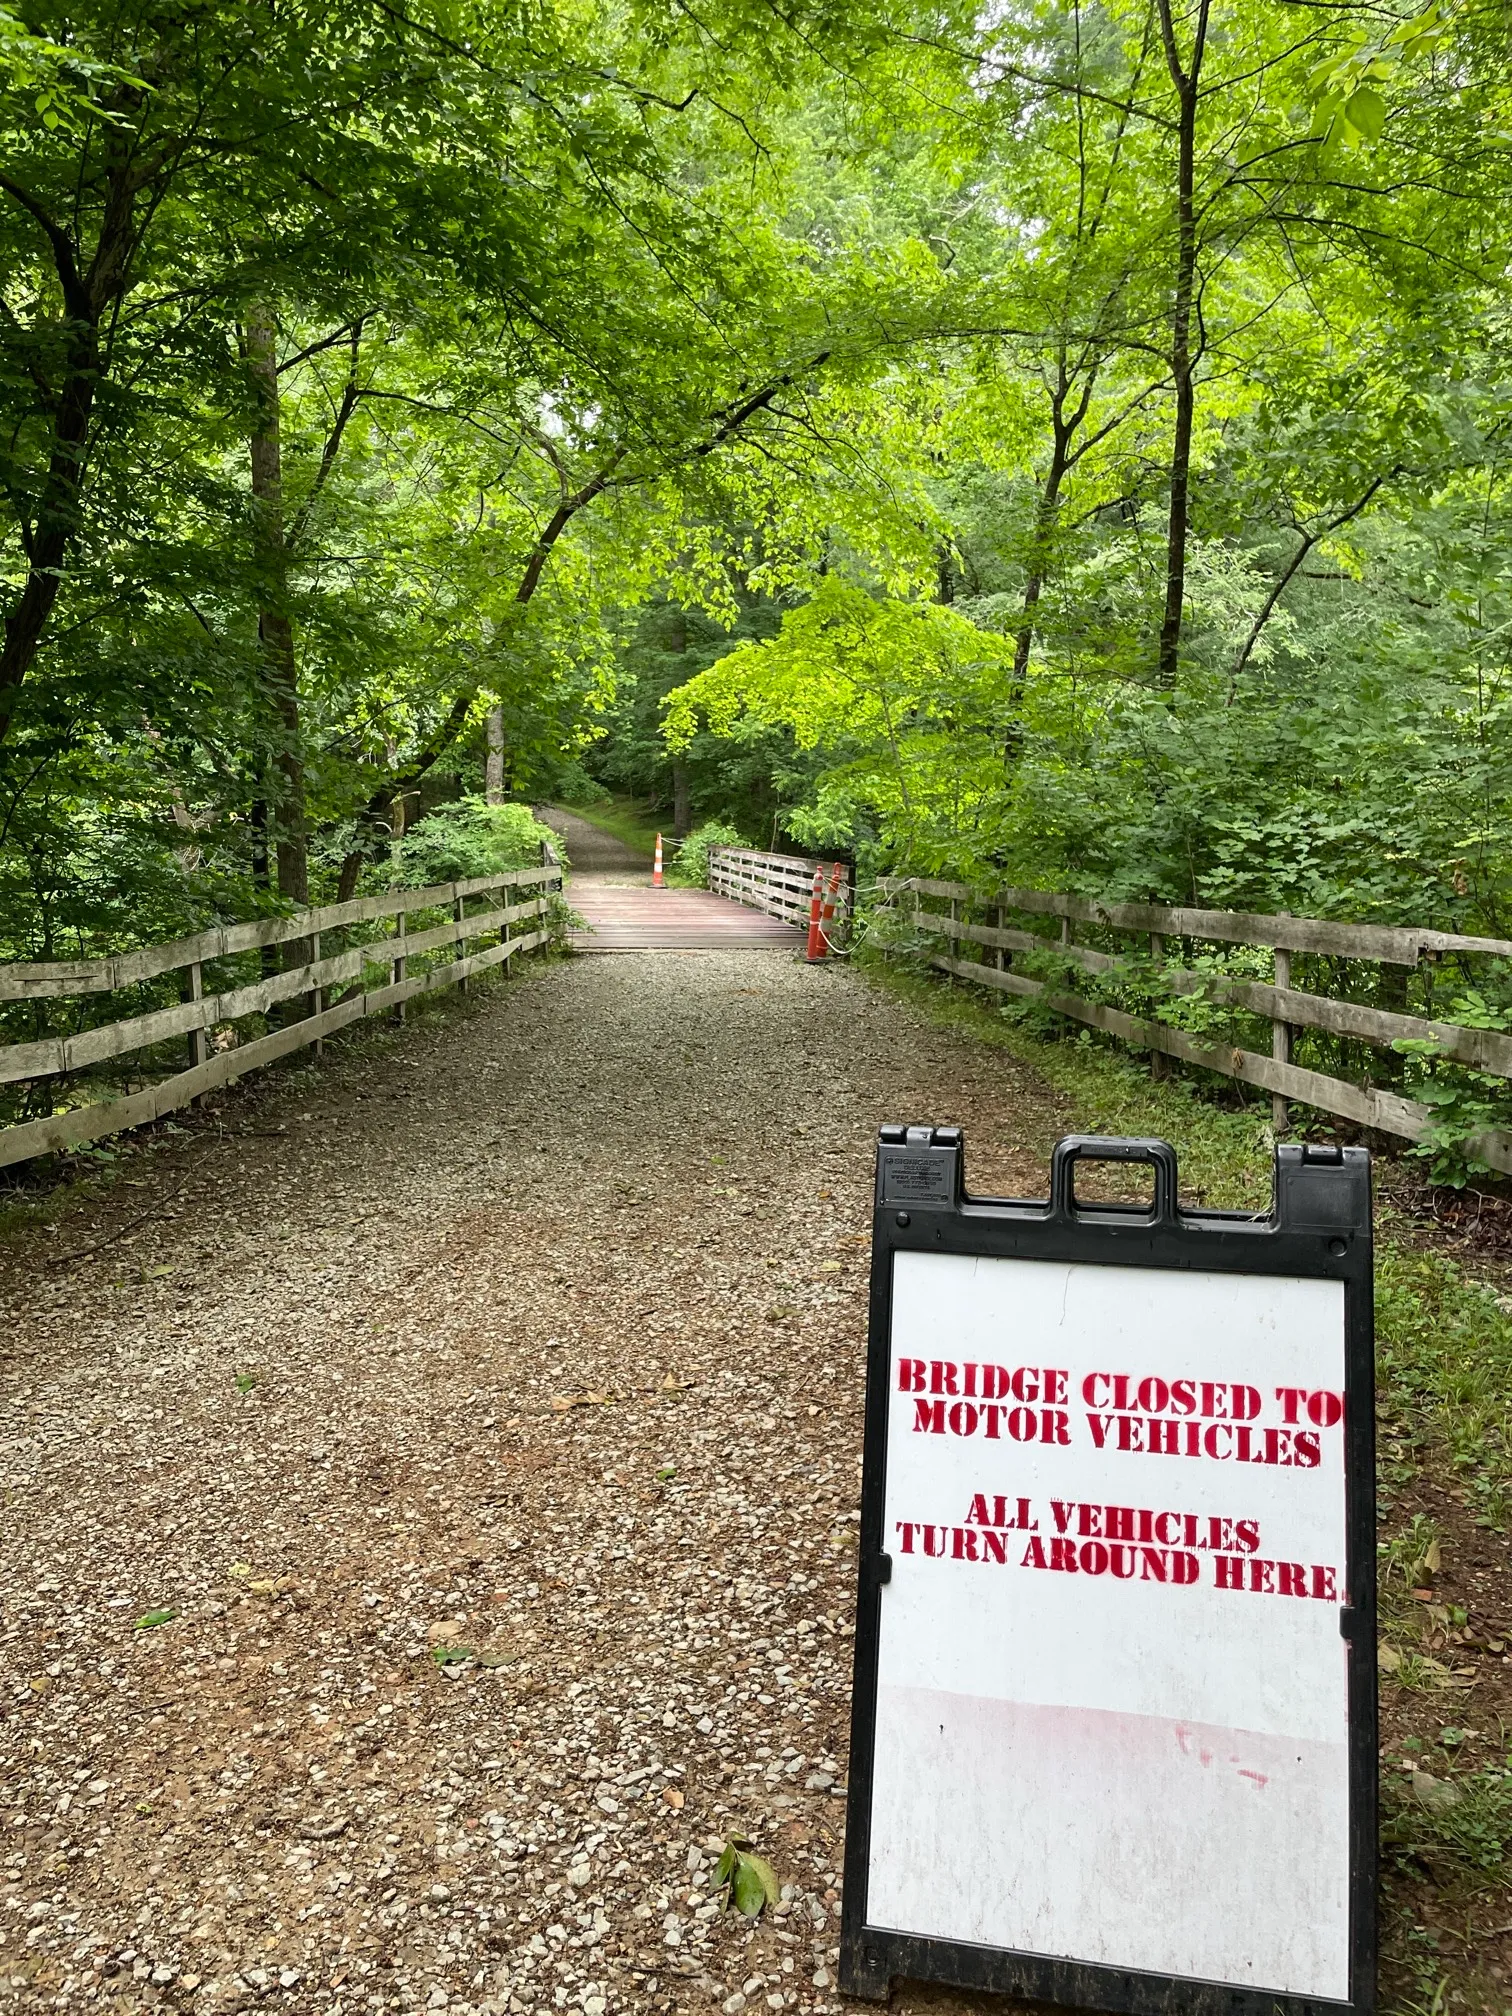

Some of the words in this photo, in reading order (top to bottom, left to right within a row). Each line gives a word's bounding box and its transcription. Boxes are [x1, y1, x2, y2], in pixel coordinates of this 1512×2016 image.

[897, 1358, 1069, 1405] BRIDGE
[1082, 1372, 1262, 1421] CLOSED
[1275, 1386, 1344, 1428] TO
[912, 1398, 1072, 1446] MOTOR
[1086, 1413, 1321, 1468] VEHICLES
[896, 1521, 1009, 1564] TURN
[1019, 1534, 1201, 1586] AROUND
[964, 1493, 1039, 1531] ALL
[1050, 1499, 1261, 1554] VEHICLES
